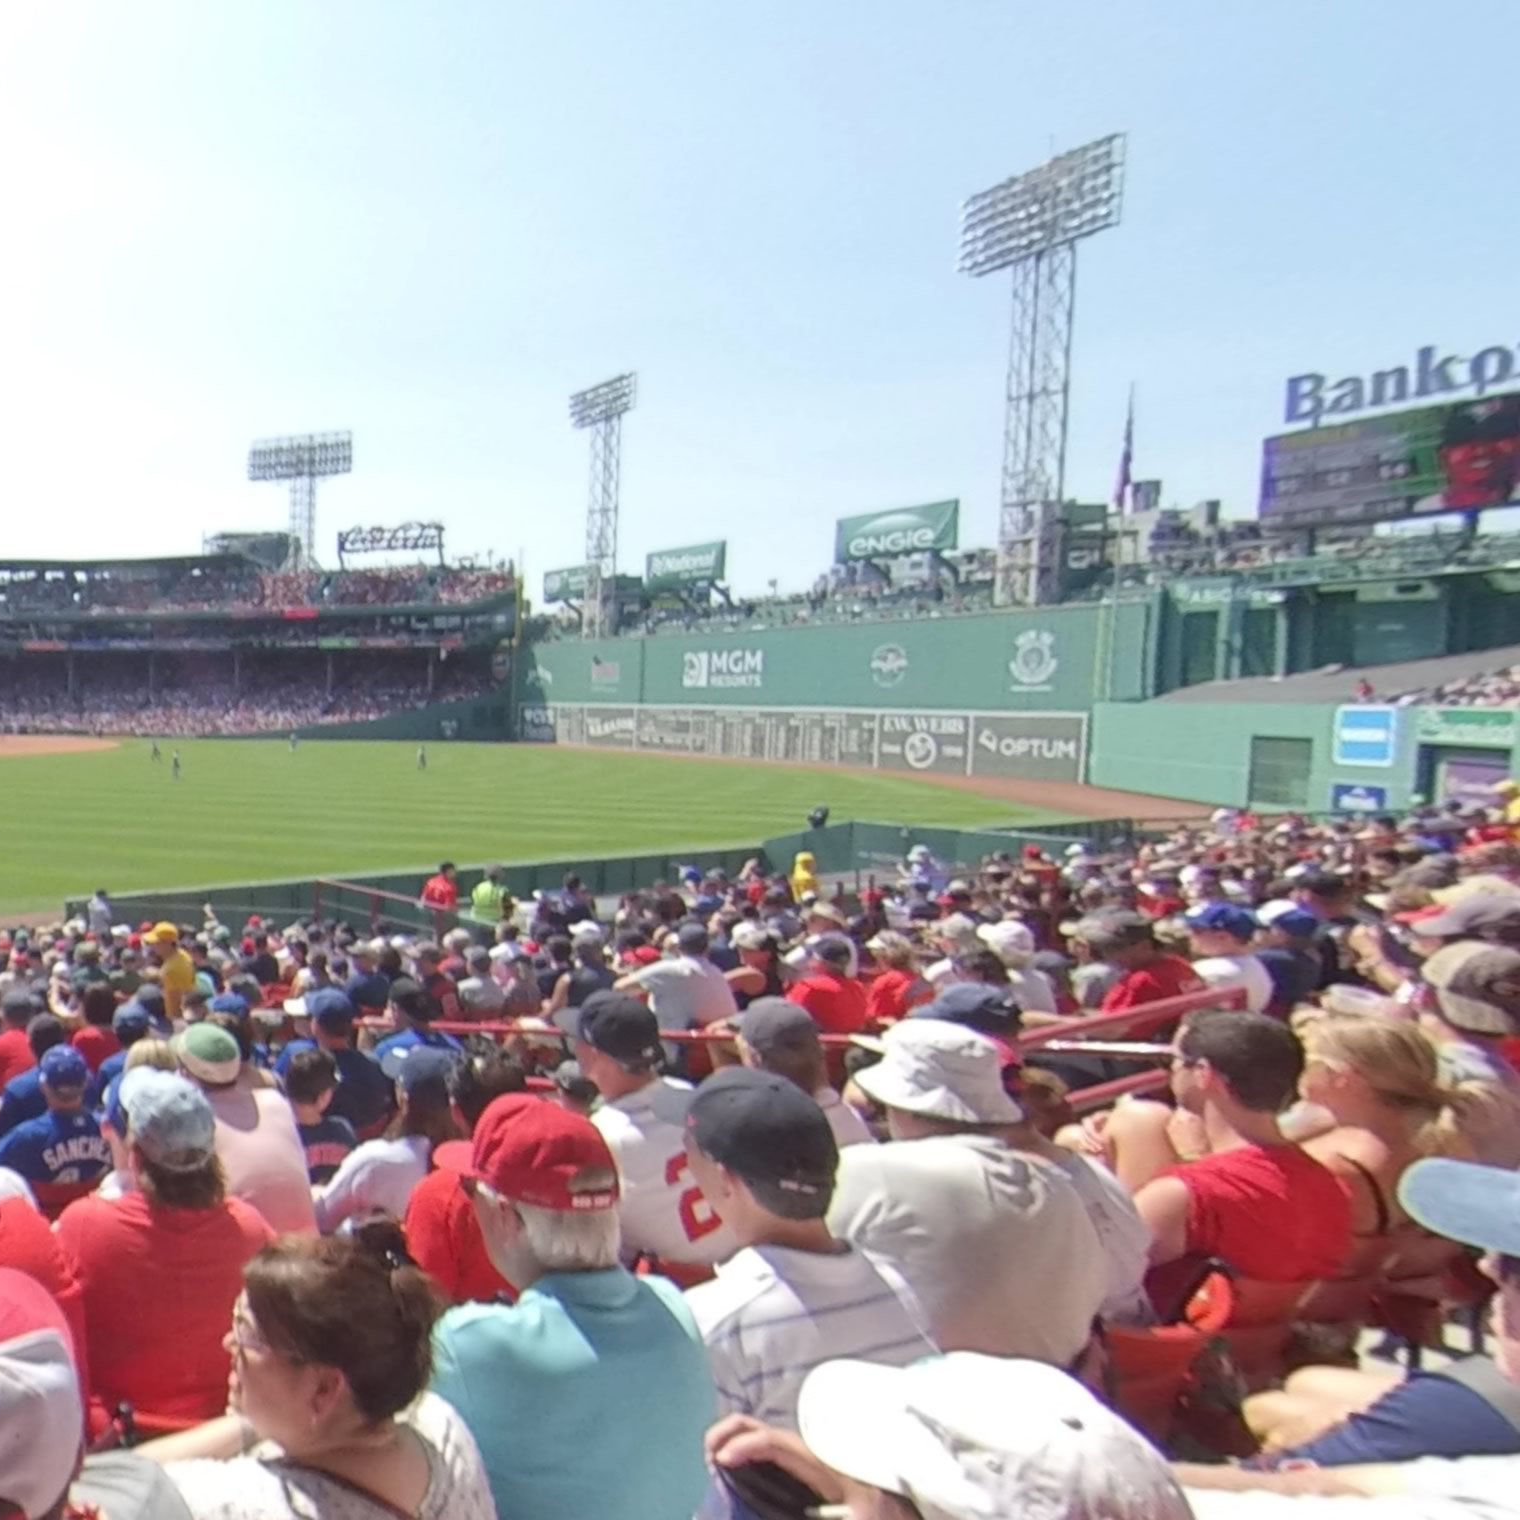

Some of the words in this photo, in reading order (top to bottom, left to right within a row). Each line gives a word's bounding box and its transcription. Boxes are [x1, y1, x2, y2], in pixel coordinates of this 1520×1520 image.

[1284, 345, 1457, 425] Bank
[1468, 343, 1520, 386] o
[711, 649, 763, 673] MGM
[1000, 737, 1077, 759] OPTUM
